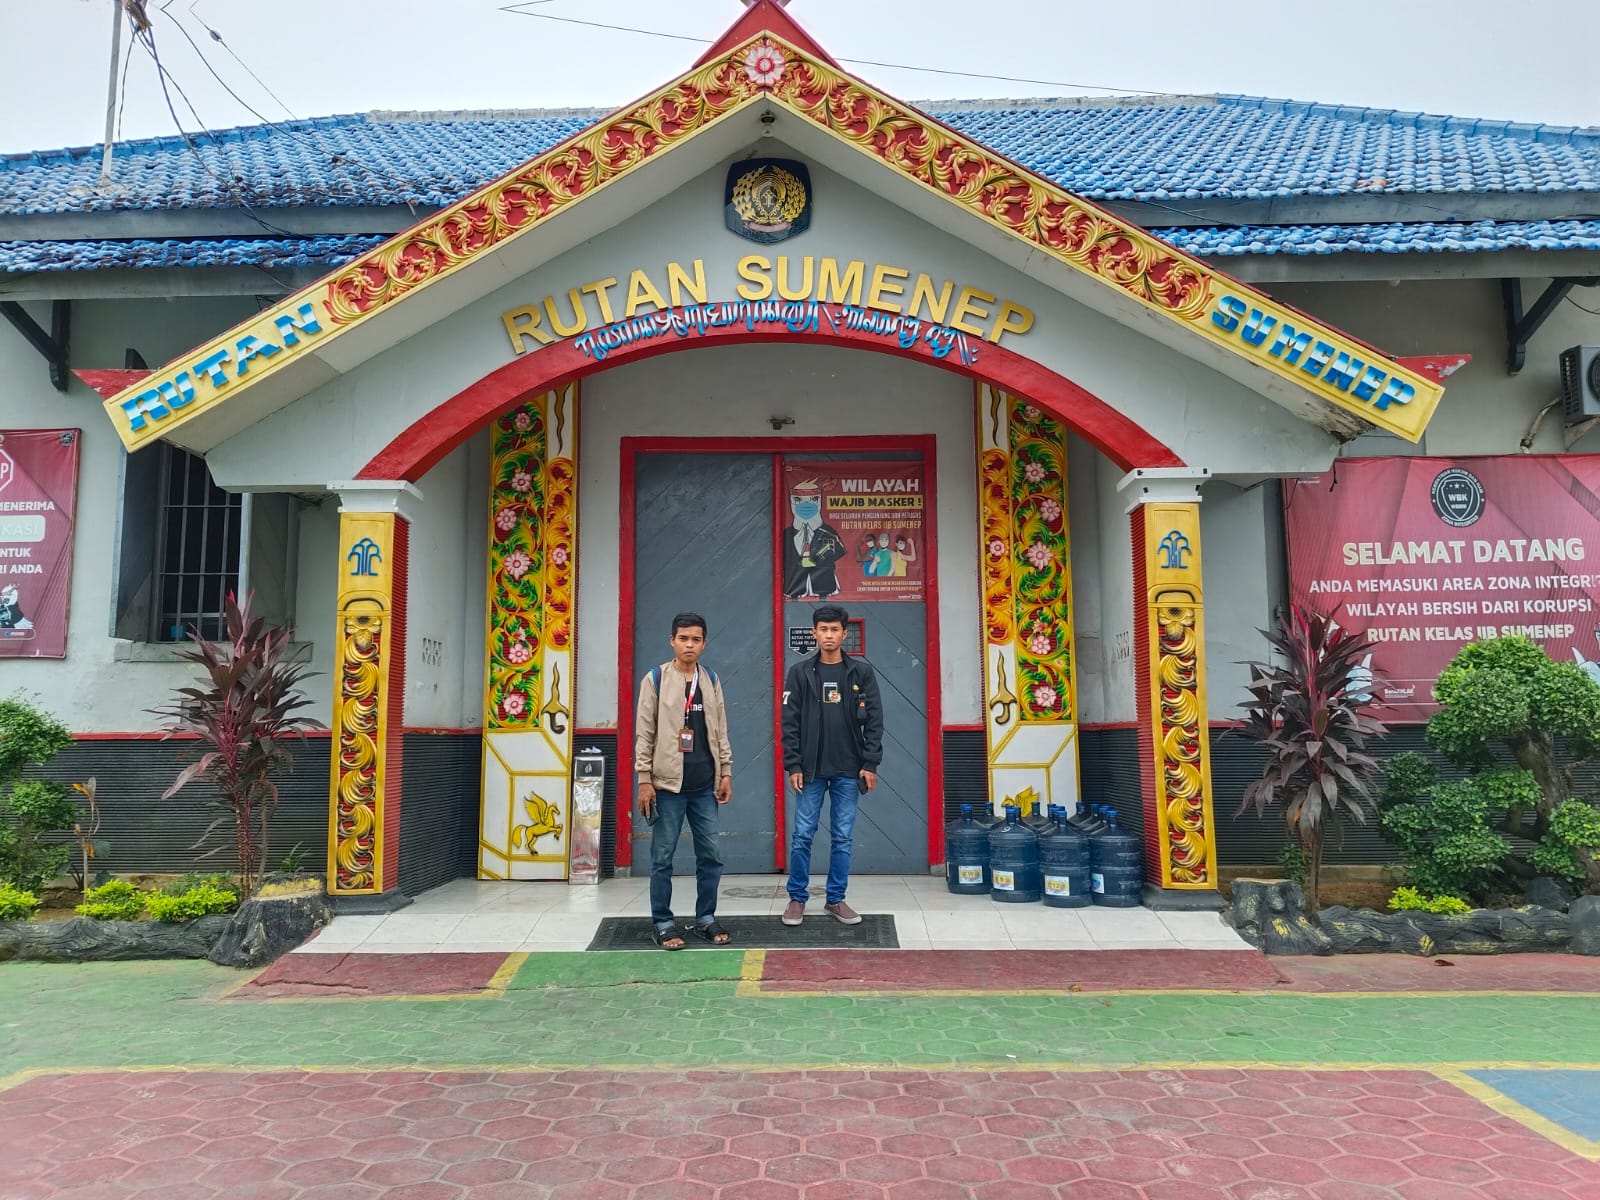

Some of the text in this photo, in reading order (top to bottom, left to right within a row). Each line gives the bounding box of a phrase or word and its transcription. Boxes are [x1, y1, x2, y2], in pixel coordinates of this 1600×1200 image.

[501, 259, 708, 355] RUTAN
[736, 255, 1035, 344] SUMENEP
[1211, 295, 1416, 411] SUMENEP
[120, 302, 323, 432] RUTAN
[841, 478, 919, 492] WILAYAH
[829, 497, 865, 507] WAJIB
[868, 497, 915, 507] MASKER
[1342, 538, 1585, 566] SELAMAT DATANG
[9, 564, 43, 574] ANDA
[1309, 580, 1353, 593] ANDA
[1357, 578, 1438, 592] MEMASUKI
[1442, 577, 1484, 591] AREA
[1488, 576, 1531, 590] ZONA
[1346, 599, 1592, 617] WILAYAH BERSIH DARI KORUPSI
[1367, 624, 1575, 642] RUTAN KELAS IIB SUMENEP
